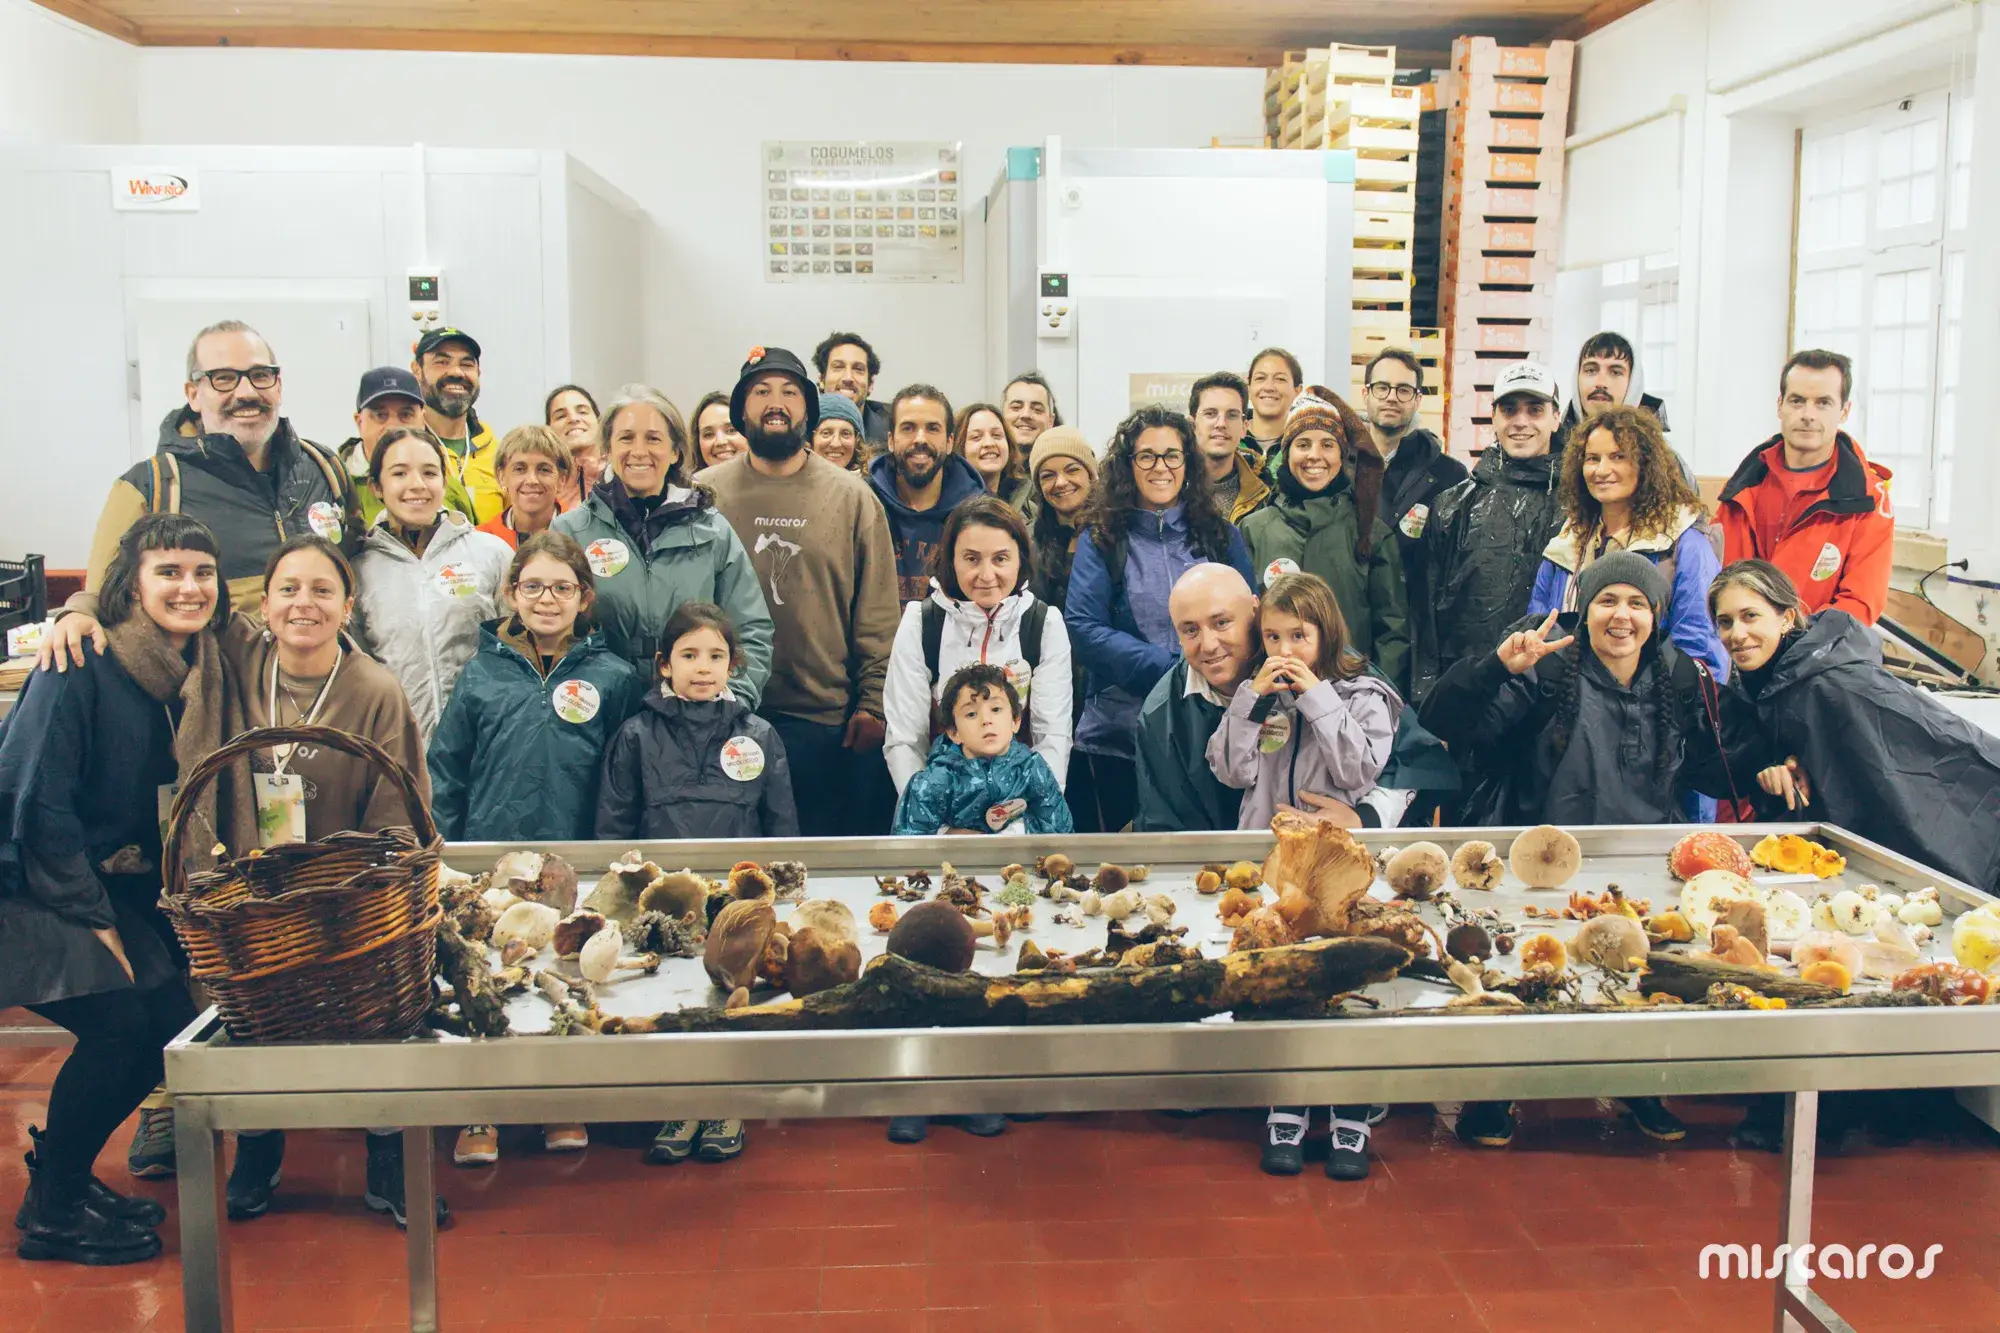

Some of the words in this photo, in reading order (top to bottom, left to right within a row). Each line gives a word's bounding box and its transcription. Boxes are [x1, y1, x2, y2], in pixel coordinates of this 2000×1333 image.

[810, 146, 894, 159] COGUMELOS
[1252, 331, 1258, 341] 2
[754, 516, 808, 528] miscaros
